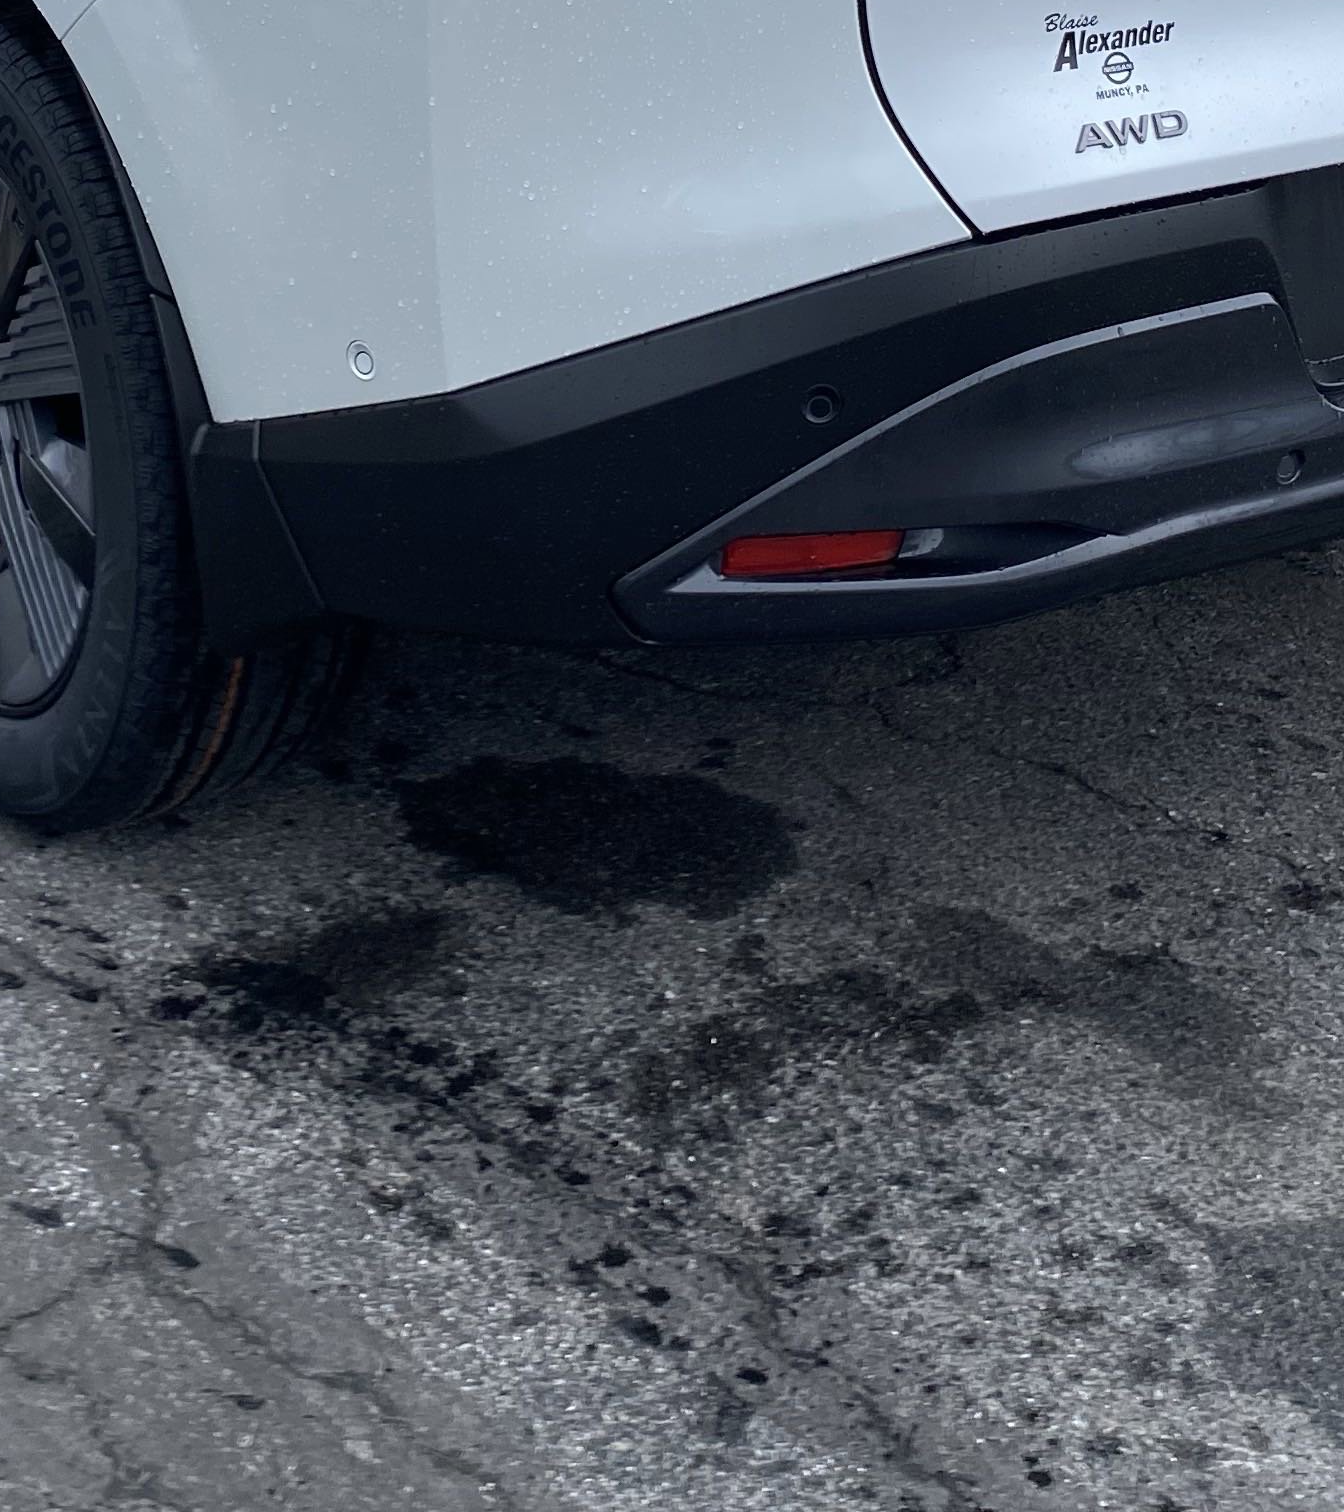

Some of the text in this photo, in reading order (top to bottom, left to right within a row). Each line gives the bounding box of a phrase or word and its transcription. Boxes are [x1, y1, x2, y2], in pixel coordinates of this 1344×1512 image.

[1044, 13, 1098, 32] Blaise
[1053, 20, 1175, 72] Alexander
[1096, 83, 1150, 100] MUNCY, PA
[1075, 109, 1189, 154] AWD
